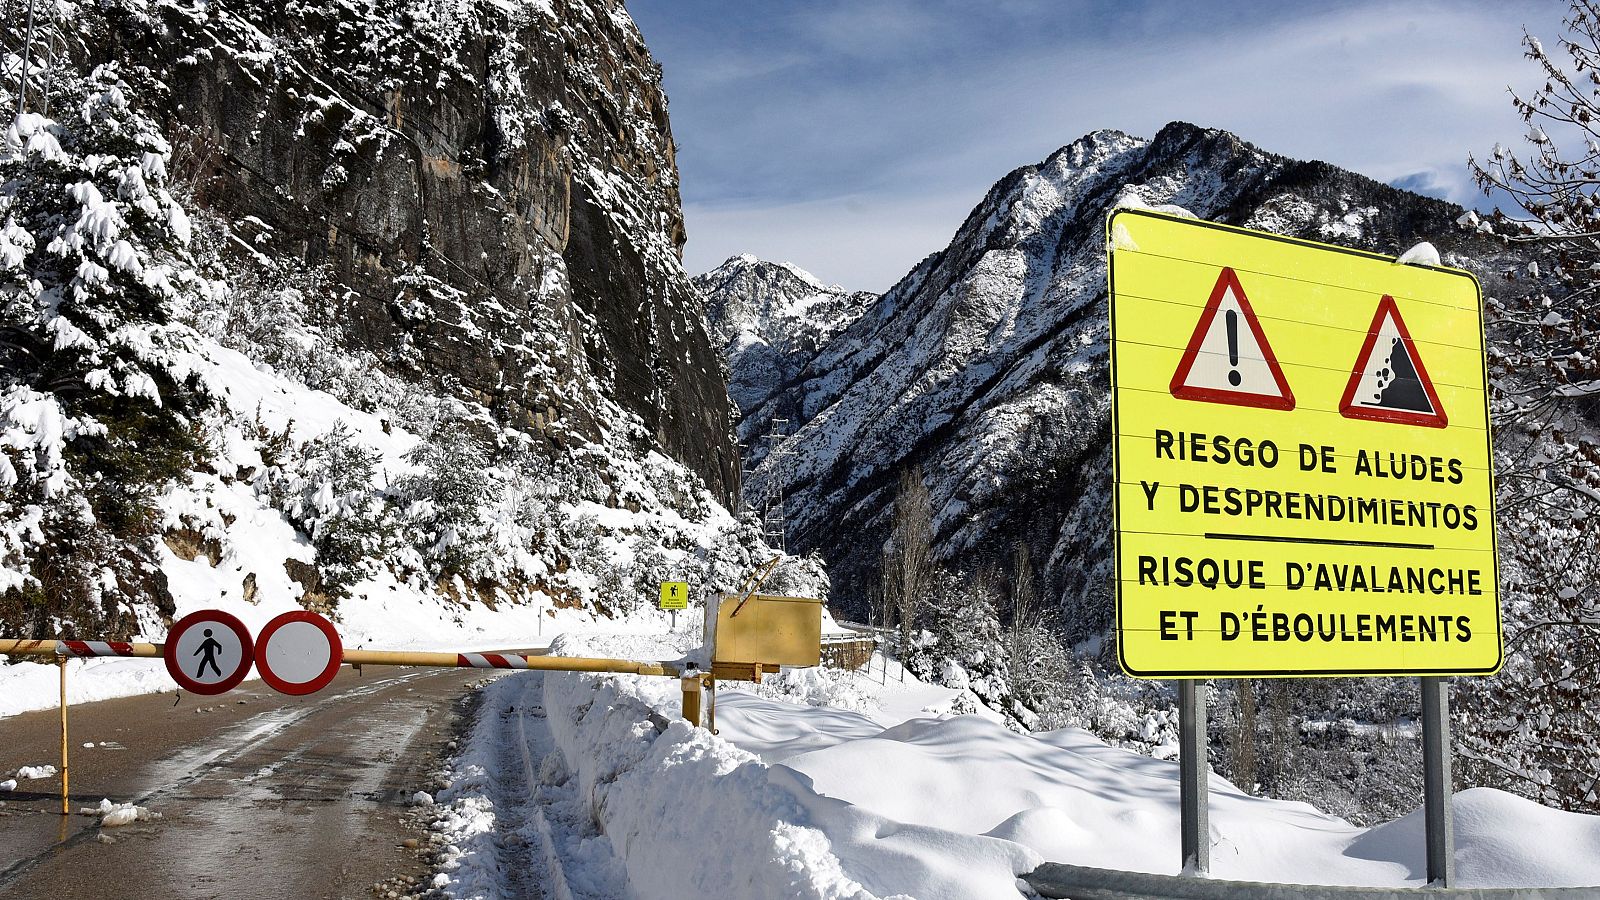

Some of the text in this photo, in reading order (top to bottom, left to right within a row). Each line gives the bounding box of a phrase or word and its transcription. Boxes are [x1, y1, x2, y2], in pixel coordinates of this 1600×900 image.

[1155, 429, 1463, 484] RIESGO DE ALUDES
[1140, 480, 1478, 530] Y DESPRENDIMIENTOS
[1138, 555, 1482, 595] RISQUE D'AVALANCHE
[1160, 605, 1472, 643] ET D'ÉBOULEMENTS
